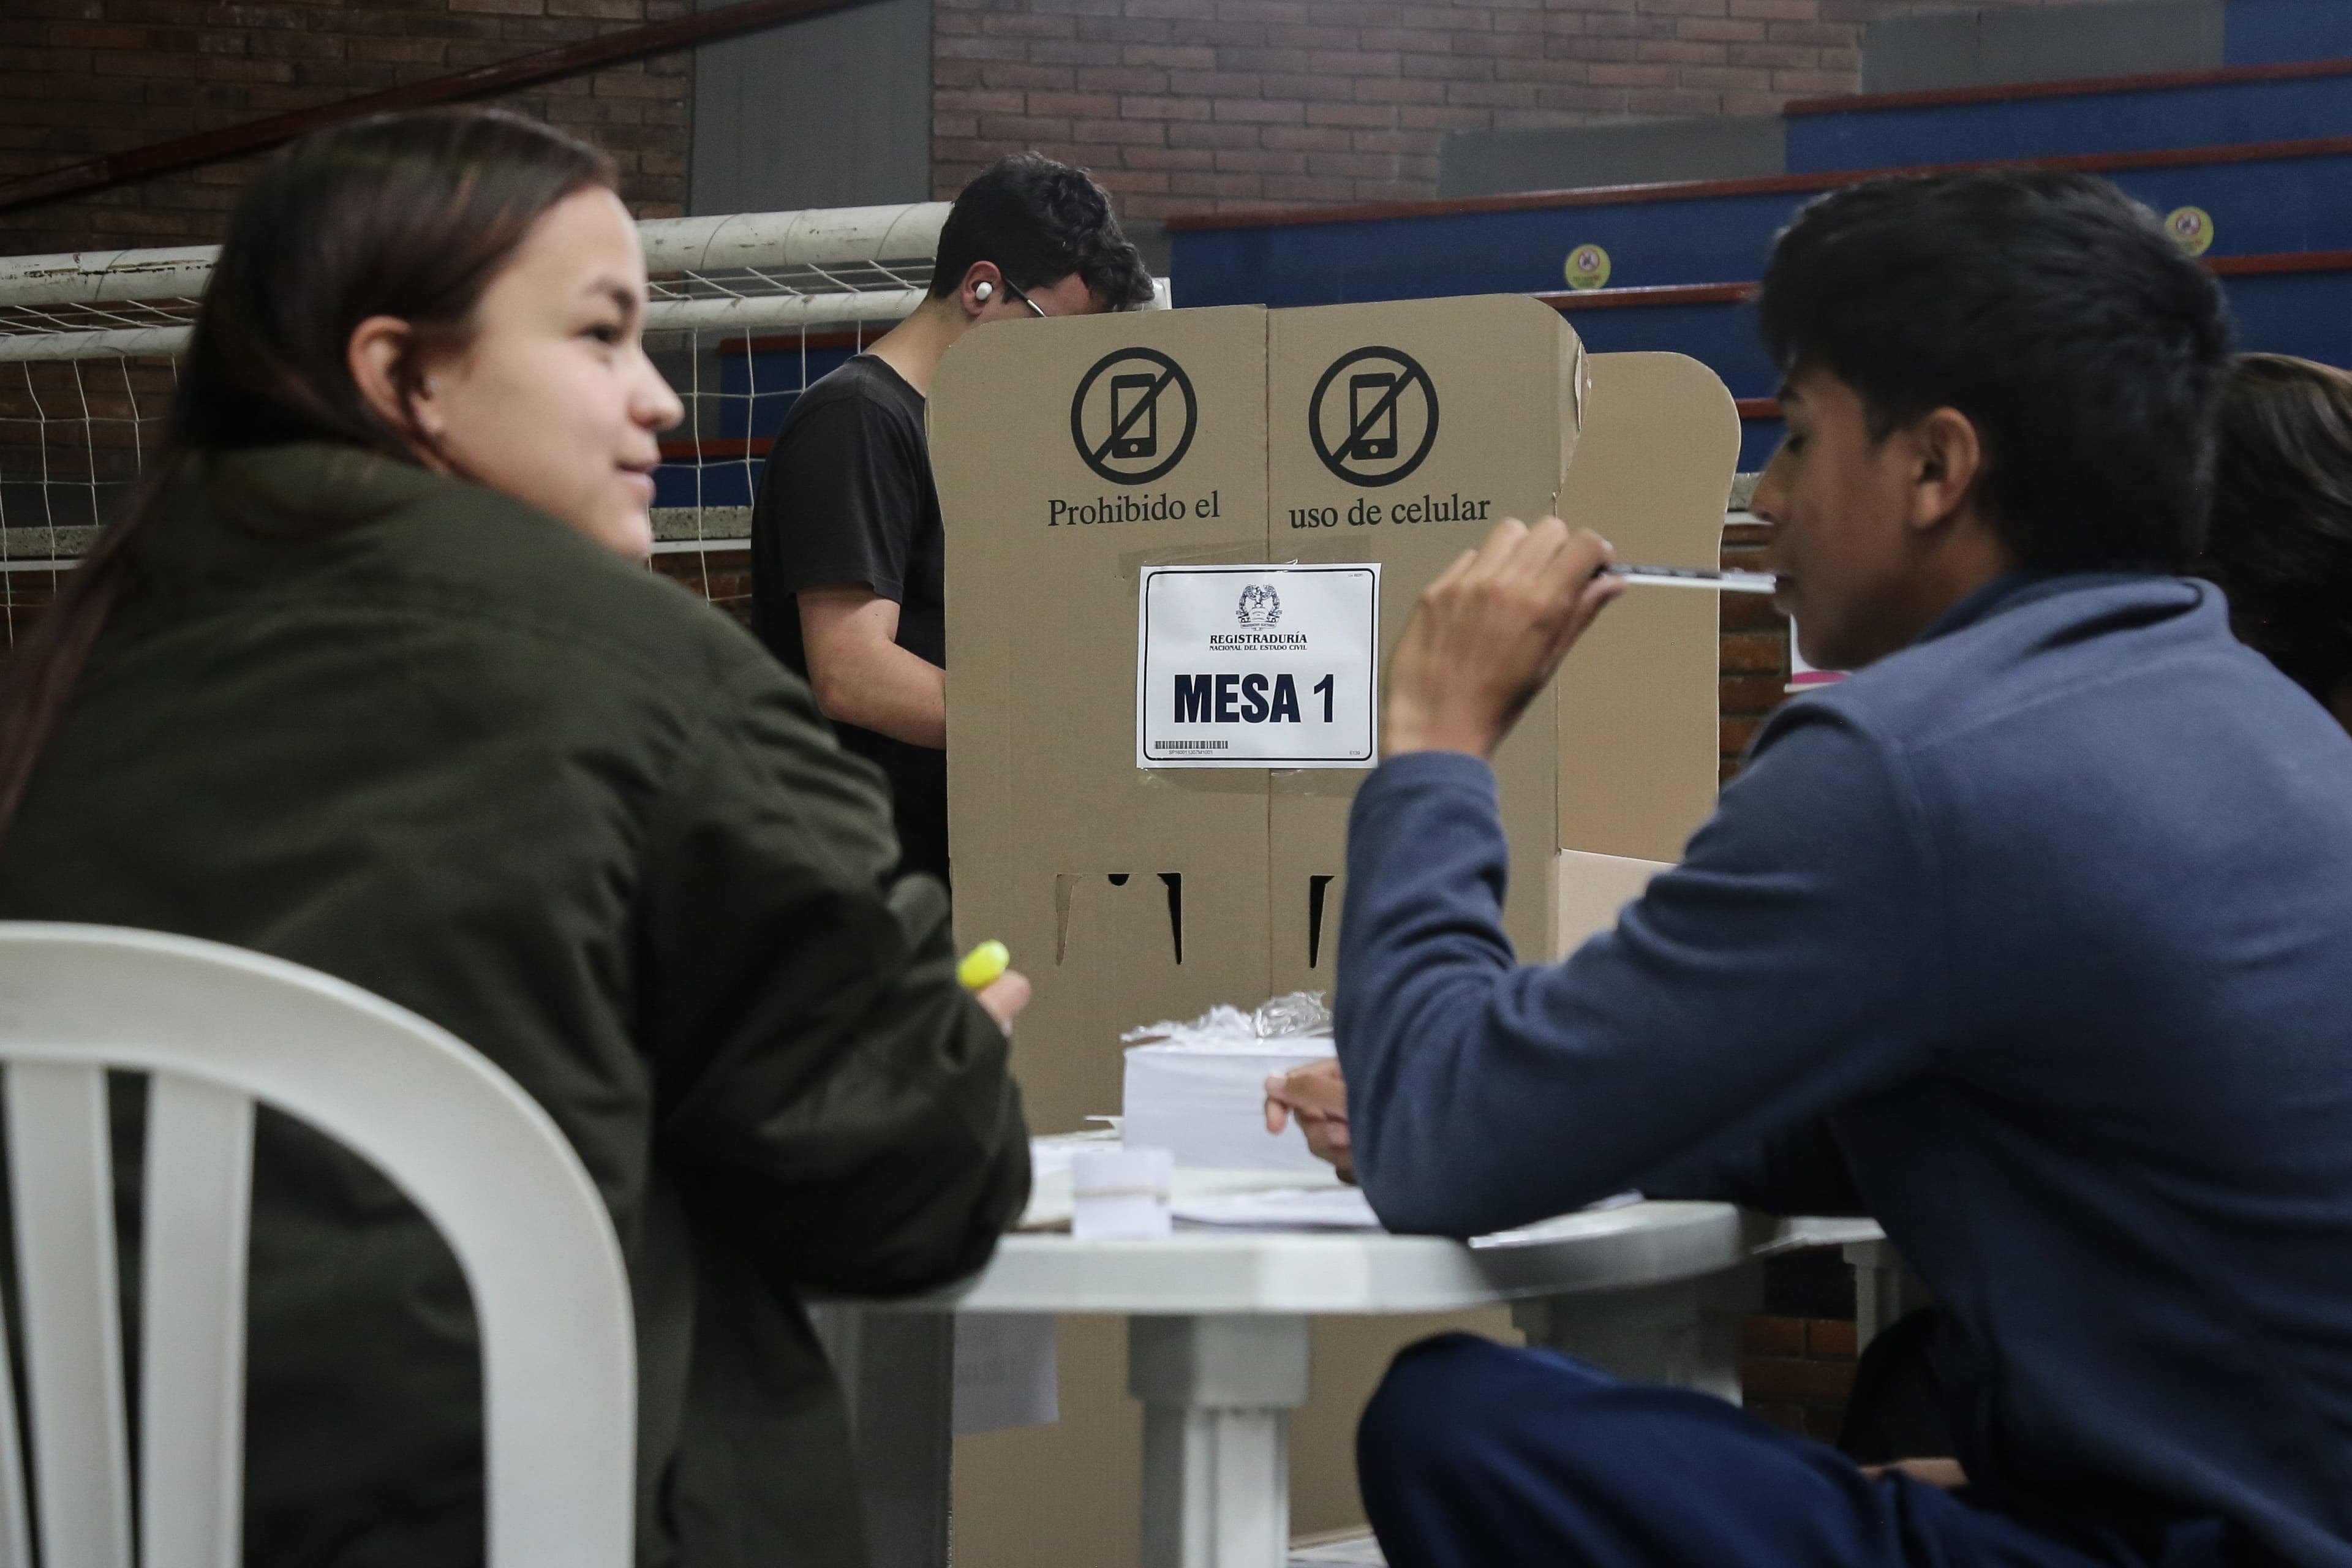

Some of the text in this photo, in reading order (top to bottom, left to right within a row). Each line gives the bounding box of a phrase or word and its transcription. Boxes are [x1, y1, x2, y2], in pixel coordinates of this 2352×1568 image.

[1048, 491, 1491, 529] Prohibido el uso de celular
[1210, 631, 1308, 644] REGISTRADURÍA
[1174, 673, 1333, 723] MESA 1
